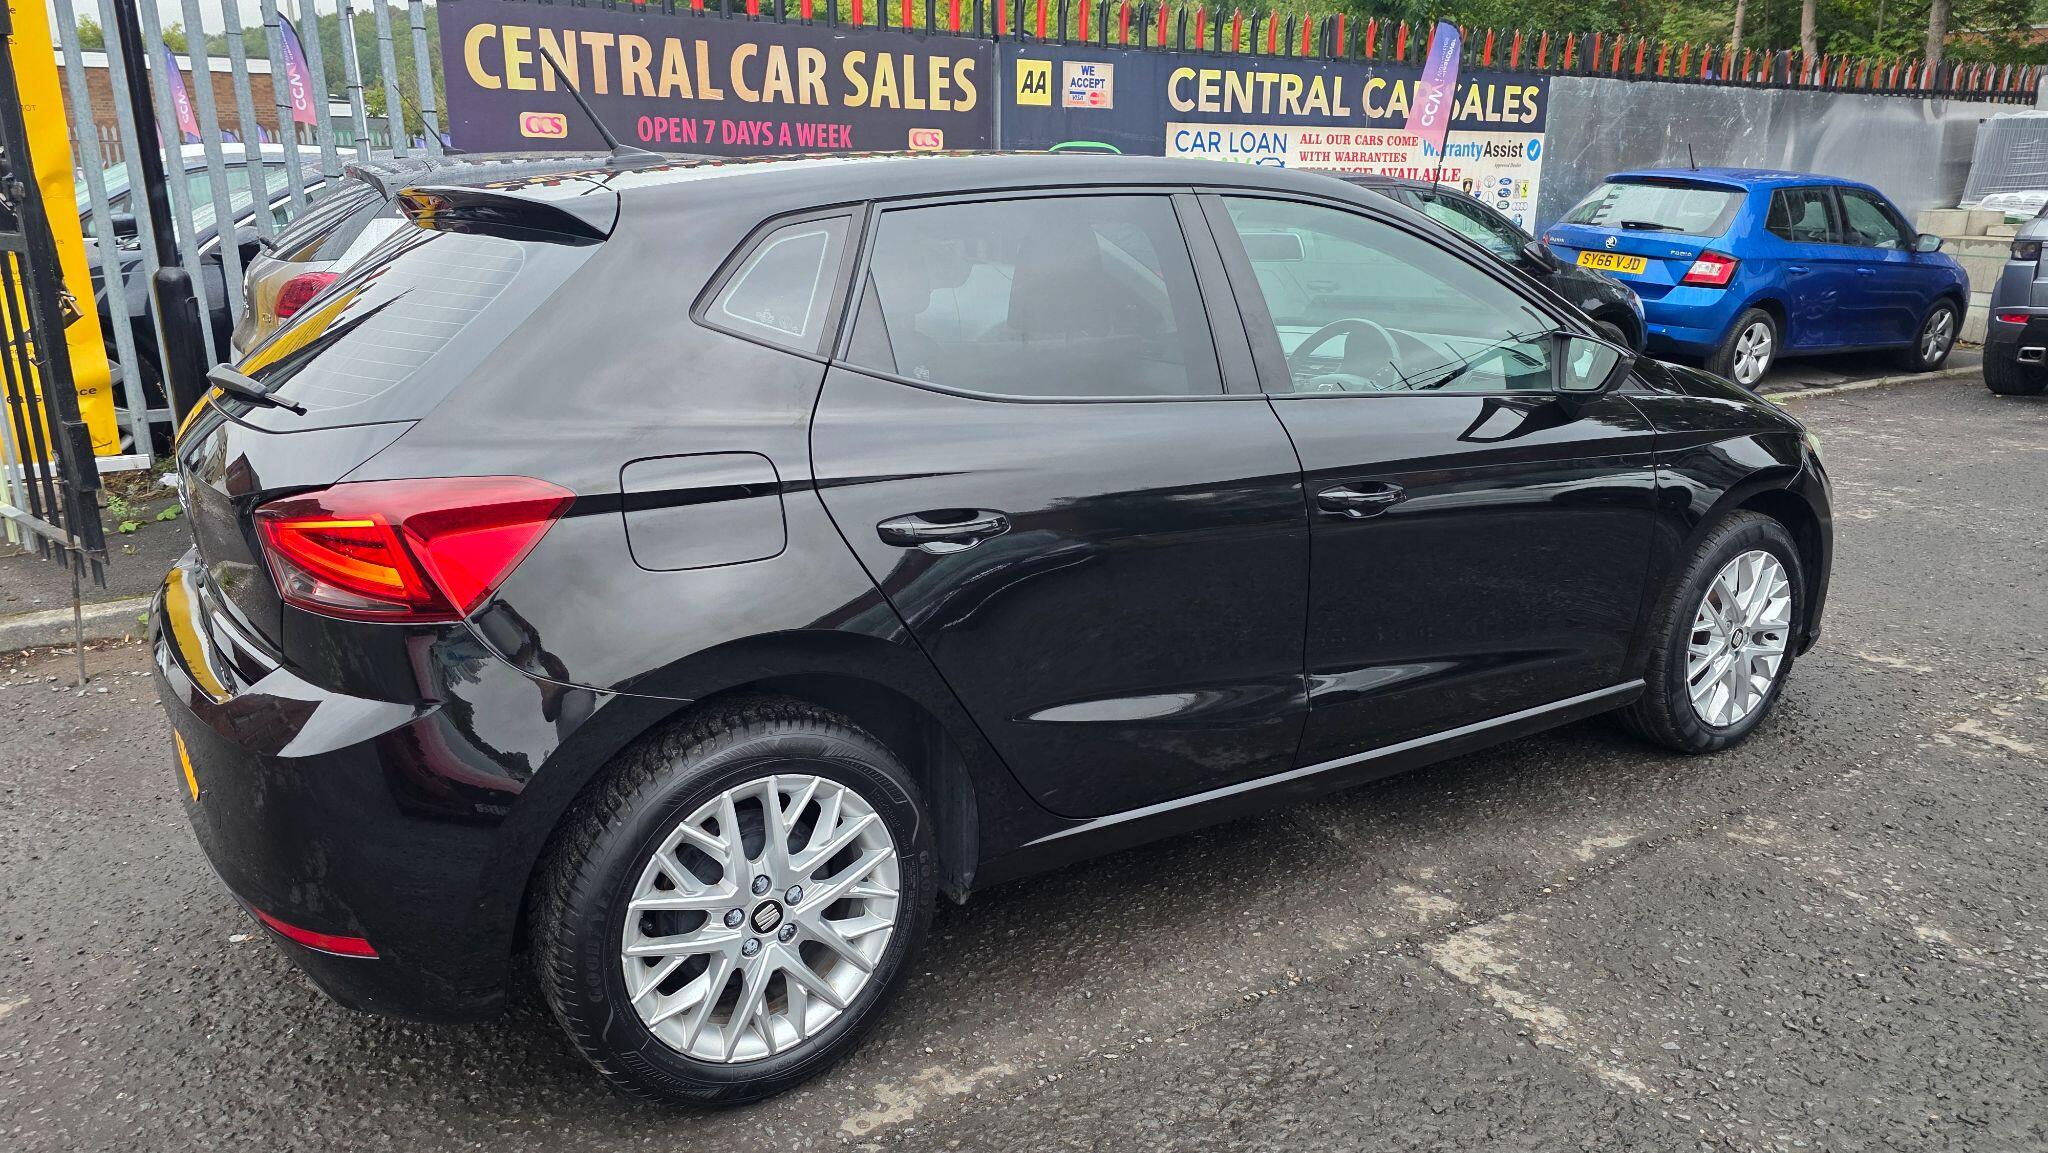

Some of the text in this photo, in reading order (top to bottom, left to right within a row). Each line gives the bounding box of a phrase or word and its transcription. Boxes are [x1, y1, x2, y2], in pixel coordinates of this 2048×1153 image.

[464, 23, 978, 112] CENTRAL CAR SALES
[1081, 65, 1095, 76] WE
[1021, 69, 1046, 95] AA
[1070, 77, 1106, 89] ACCEPT
[1167, 67, 1350, 117] CENTRAL
[525, 115, 564, 135] CCS
[637, 116, 853, 148] OPEN 7 DAYS A WEEK
[1175, 130, 1287, 154] CAR LOAN
[1300, 133, 1419, 147] ALL OUR CARS COME
[1299, 151, 1408, 163] WITH WARRANTIES
[1582, 252, 1641, 270] SY66 VJD
